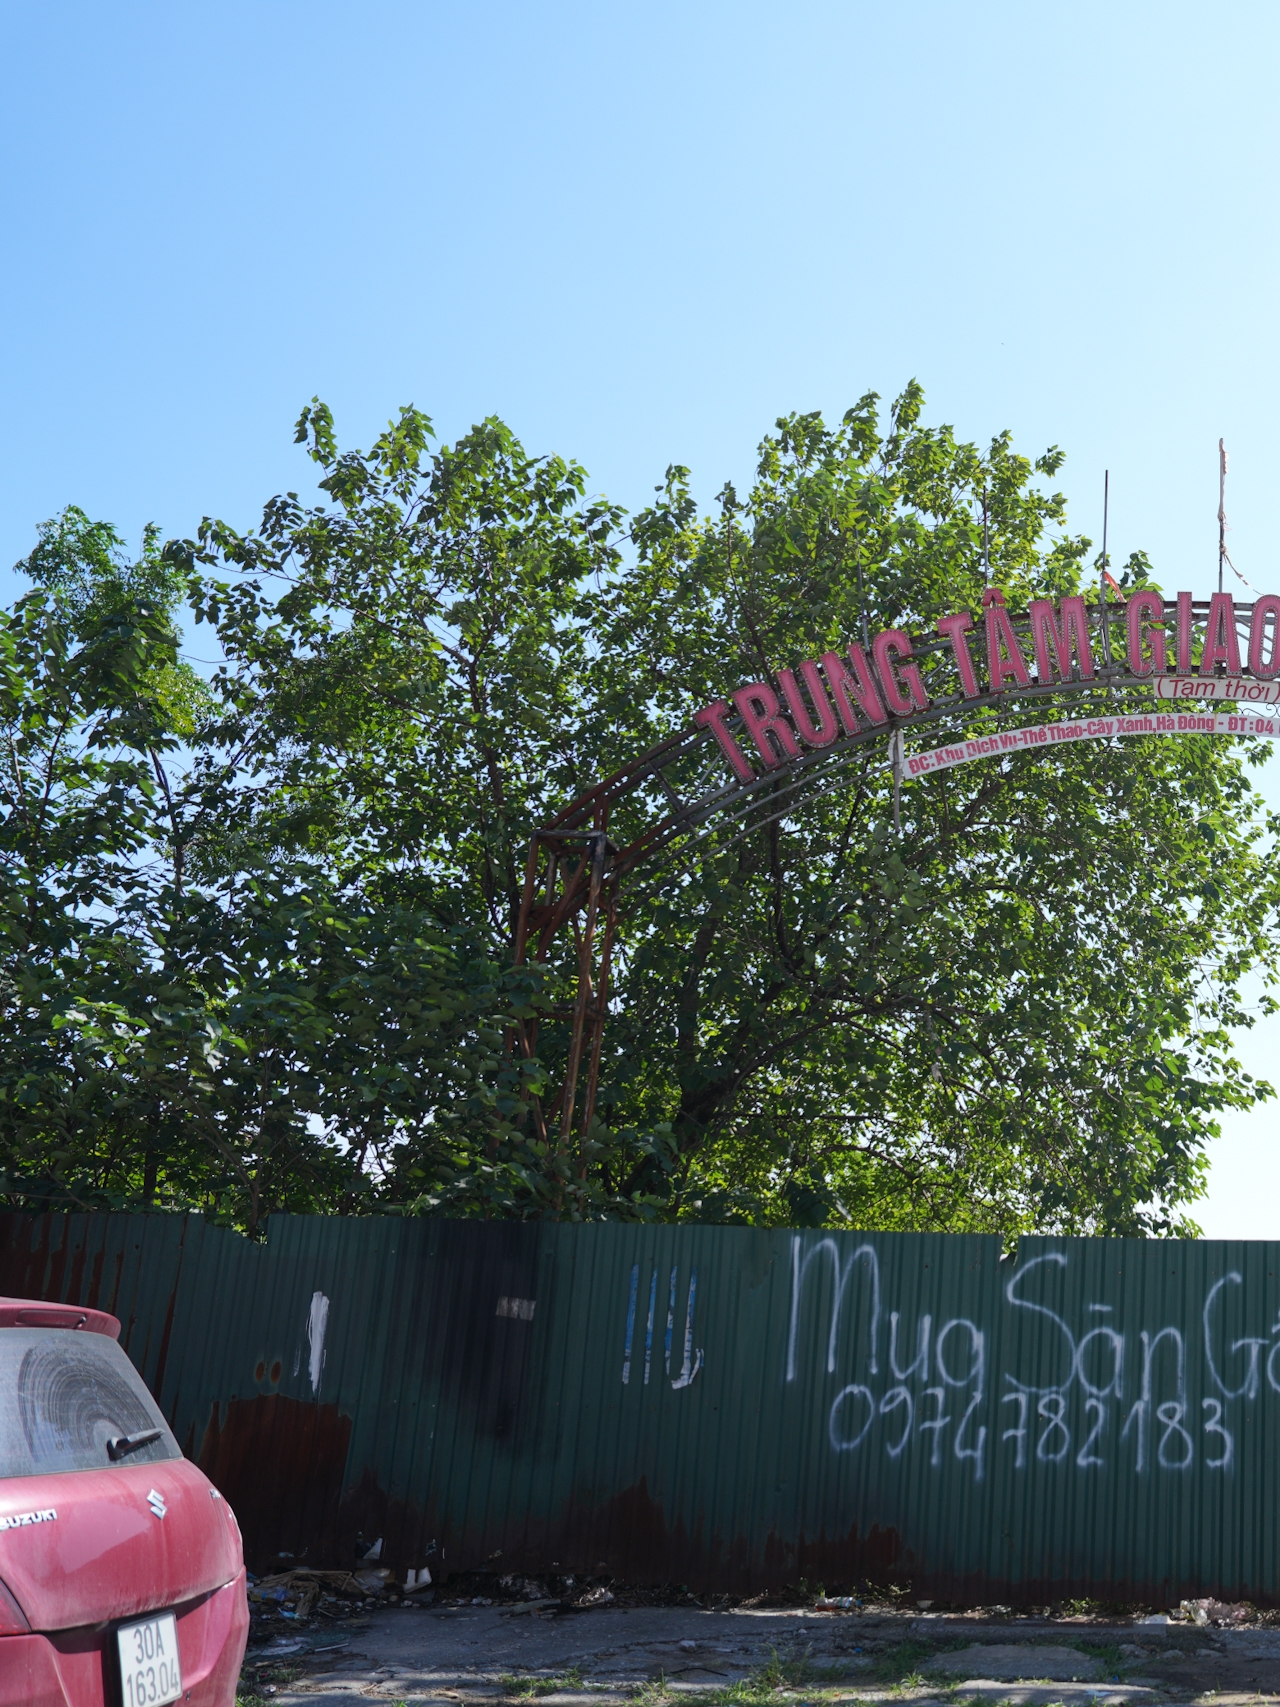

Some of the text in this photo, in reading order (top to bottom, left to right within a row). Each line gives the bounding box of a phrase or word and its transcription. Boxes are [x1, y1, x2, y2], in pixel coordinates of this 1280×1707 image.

[694, 629, 931, 786] TRUNG
[936, 587, 1096, 700] TÂM
[908, 753, 936, 775] ĐC:
[936, 748, 965, 767] Khu
[1178, 715, 1215, 732] Đông
[0, 1508, 57, 1531] SUZUKI
[133, 1620, 165, 1664] 30A
[127, 1657, 179, 1707] 163.04
